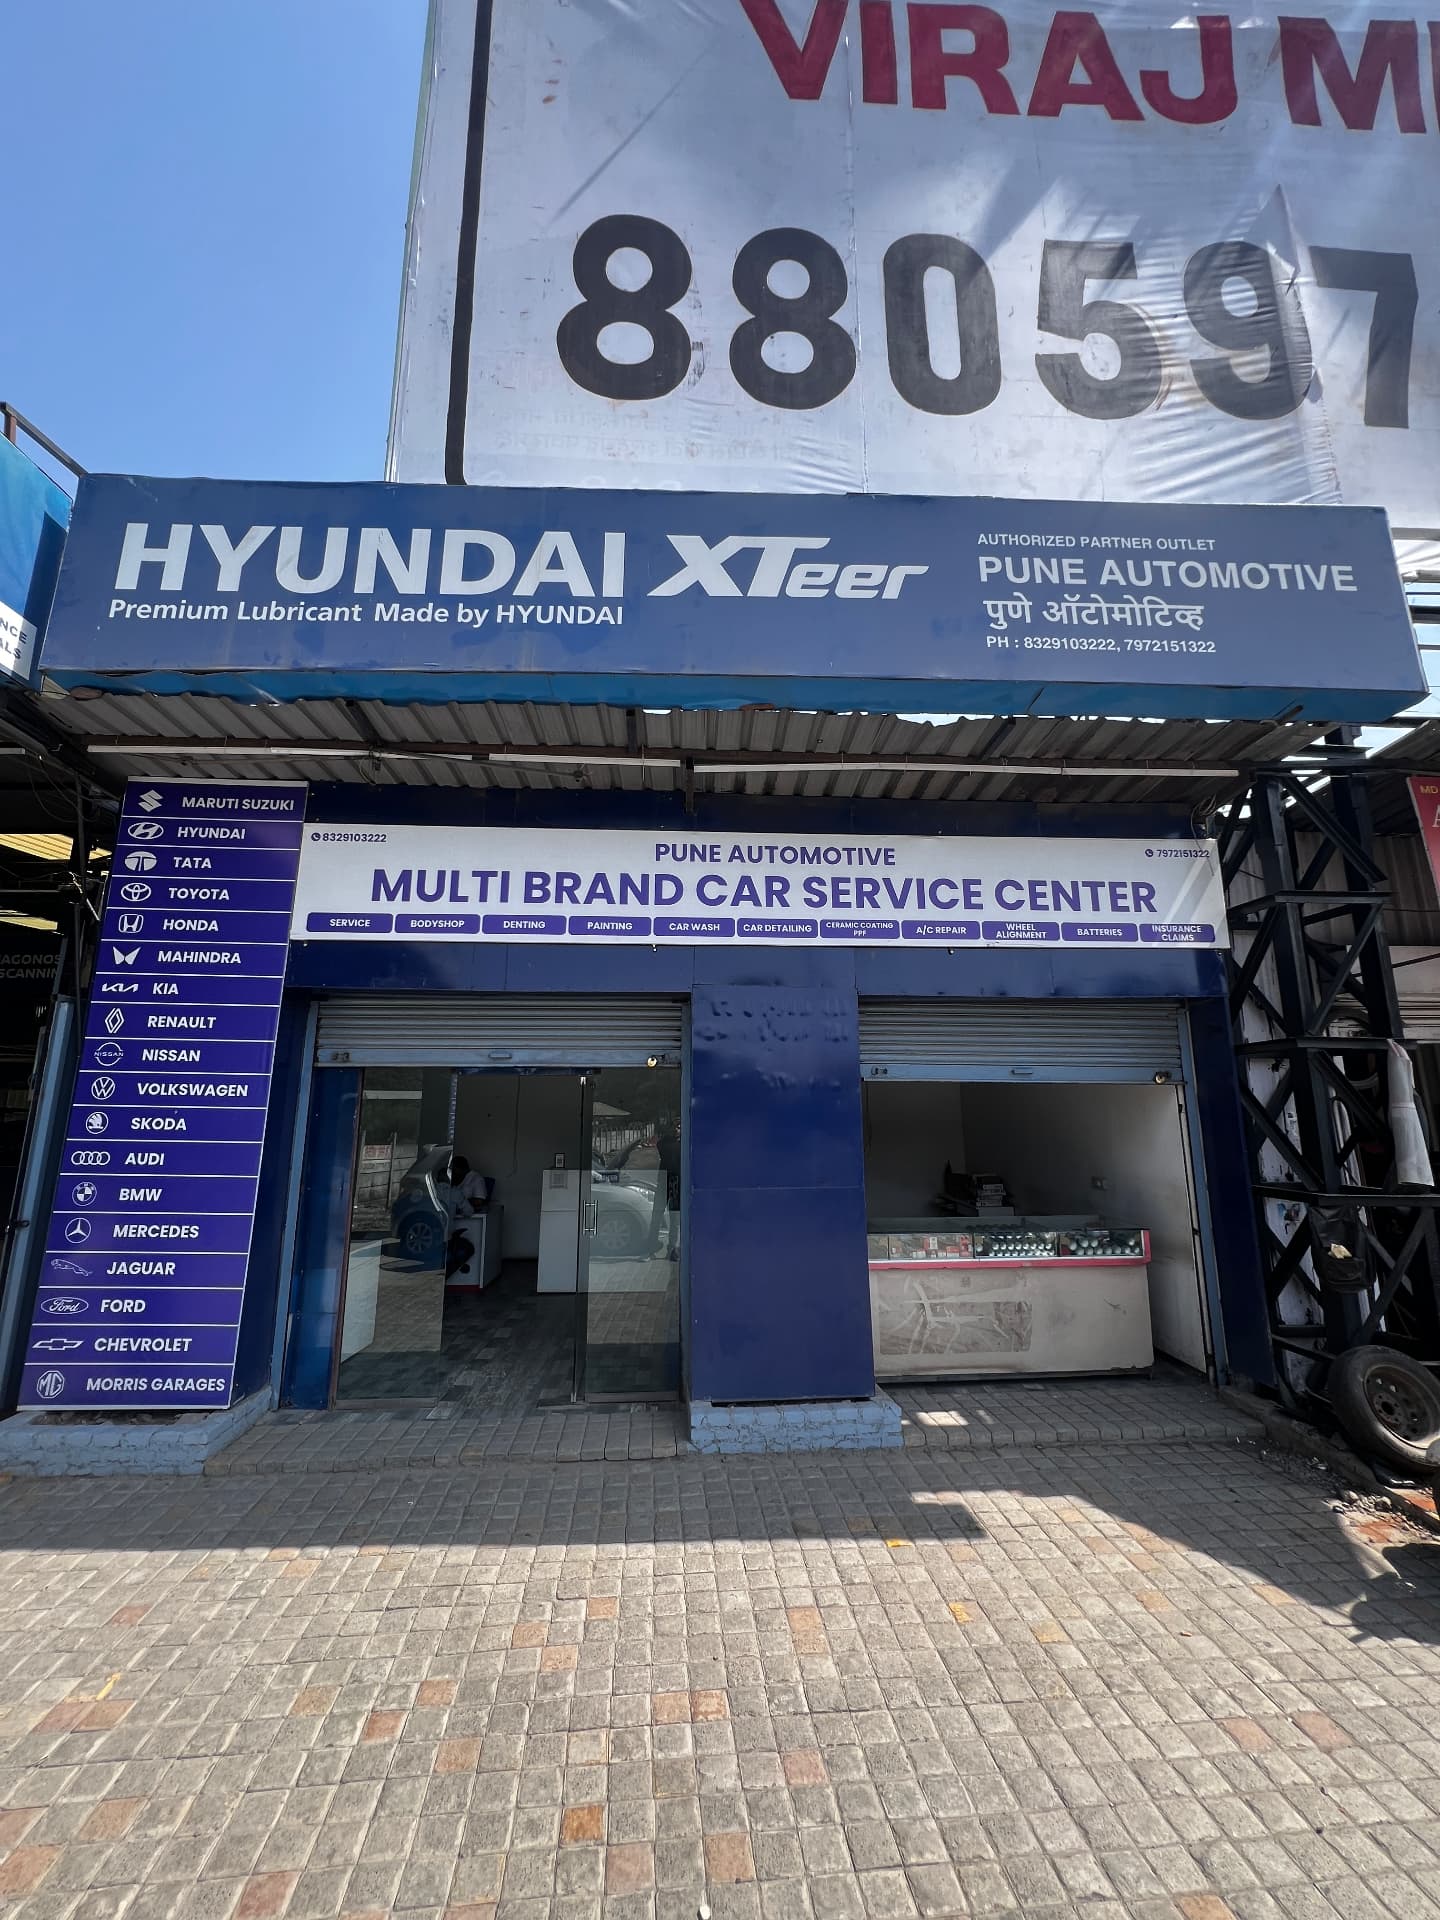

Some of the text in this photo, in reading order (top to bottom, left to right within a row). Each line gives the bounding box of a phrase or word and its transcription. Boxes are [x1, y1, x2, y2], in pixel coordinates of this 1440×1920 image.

[740, 0, 1440, 135] VIRAJ M
[556, 214, 1419, 429] 880597
[977, 534, 1216, 551] AUTHORIZED PARTNER OUTLET
[115, 522, 929, 599] HYUNDAI XTeer
[978, 556, 1357, 592] PUNE AUTOMOTIVE
[108, 599, 624, 628] Premium Lubricant Made by HYUNDAI
[983, 592, 1205, 630] पुणे ऑटोमोटिव्ह
[986, 636, 1009, 648] PH
[1023, 636, 1121, 652] 8329103222,
[1124, 639, 1217, 653] 7972151322
[182, 796, 295, 811] MARUTI SUZUKI
[177, 826, 246, 840] HYUNDAI
[322, 832, 387, 843] 8329103222
[655, 843, 896, 866] PUNE AUTOMOTIVE
[1156, 849, 1210, 859] 7972151322
[173, 856, 212, 870] TATA
[169, 887, 230, 901] TOYOTA
[371, 869, 1158, 912] MULTI BRAND CAR SERVICE CENTER
[163, 918, 219, 932] HONDA
[329, 918, 371, 928] SERVICE
[410, 918, 465, 929] BODYSHOP
[503, 920, 546, 930] DENTING
[587, 921, 633, 931] PAINTING
[669, 922, 720, 932] CAR WASH
[743, 923, 812, 933] CAR DETAILING
[826, 922, 893, 930] CERAMIC COATING
[1006, 923, 1036, 932] WHEEL
[1152, 925, 1202, 934] INSURANCE
[916, 925, 967, 936] A/C REPAIR
[996, 930, 1047, 940] ALIGNMENT
[1077, 928, 1122, 937] BATTERIES
[1162, 933, 1194, 943] CLAIMS
[0, 954, 62, 965] AGONOS
[157, 950, 242, 965] MAHINDRA
[152, 982, 179, 995] KIA
[147, 1014, 216, 1029] RENAULT
[142, 1048, 201, 1062] NISSAN
[137, 1082, 249, 1098] VOLKSWAGEN
[130, 1116, 187, 1131] SKODA
[124, 1152, 165, 1166] AUDI
[119, 1188, 162, 1202] BMW
[113, 1224, 200, 1239] MERCEDES
[106, 1261, 176, 1277] JAGUAR
[100, 1299, 146, 1314] FORD
[94, 1337, 192, 1353] CHEVROLET
[86, 1377, 226, 1393] MORRIS GARAGES
